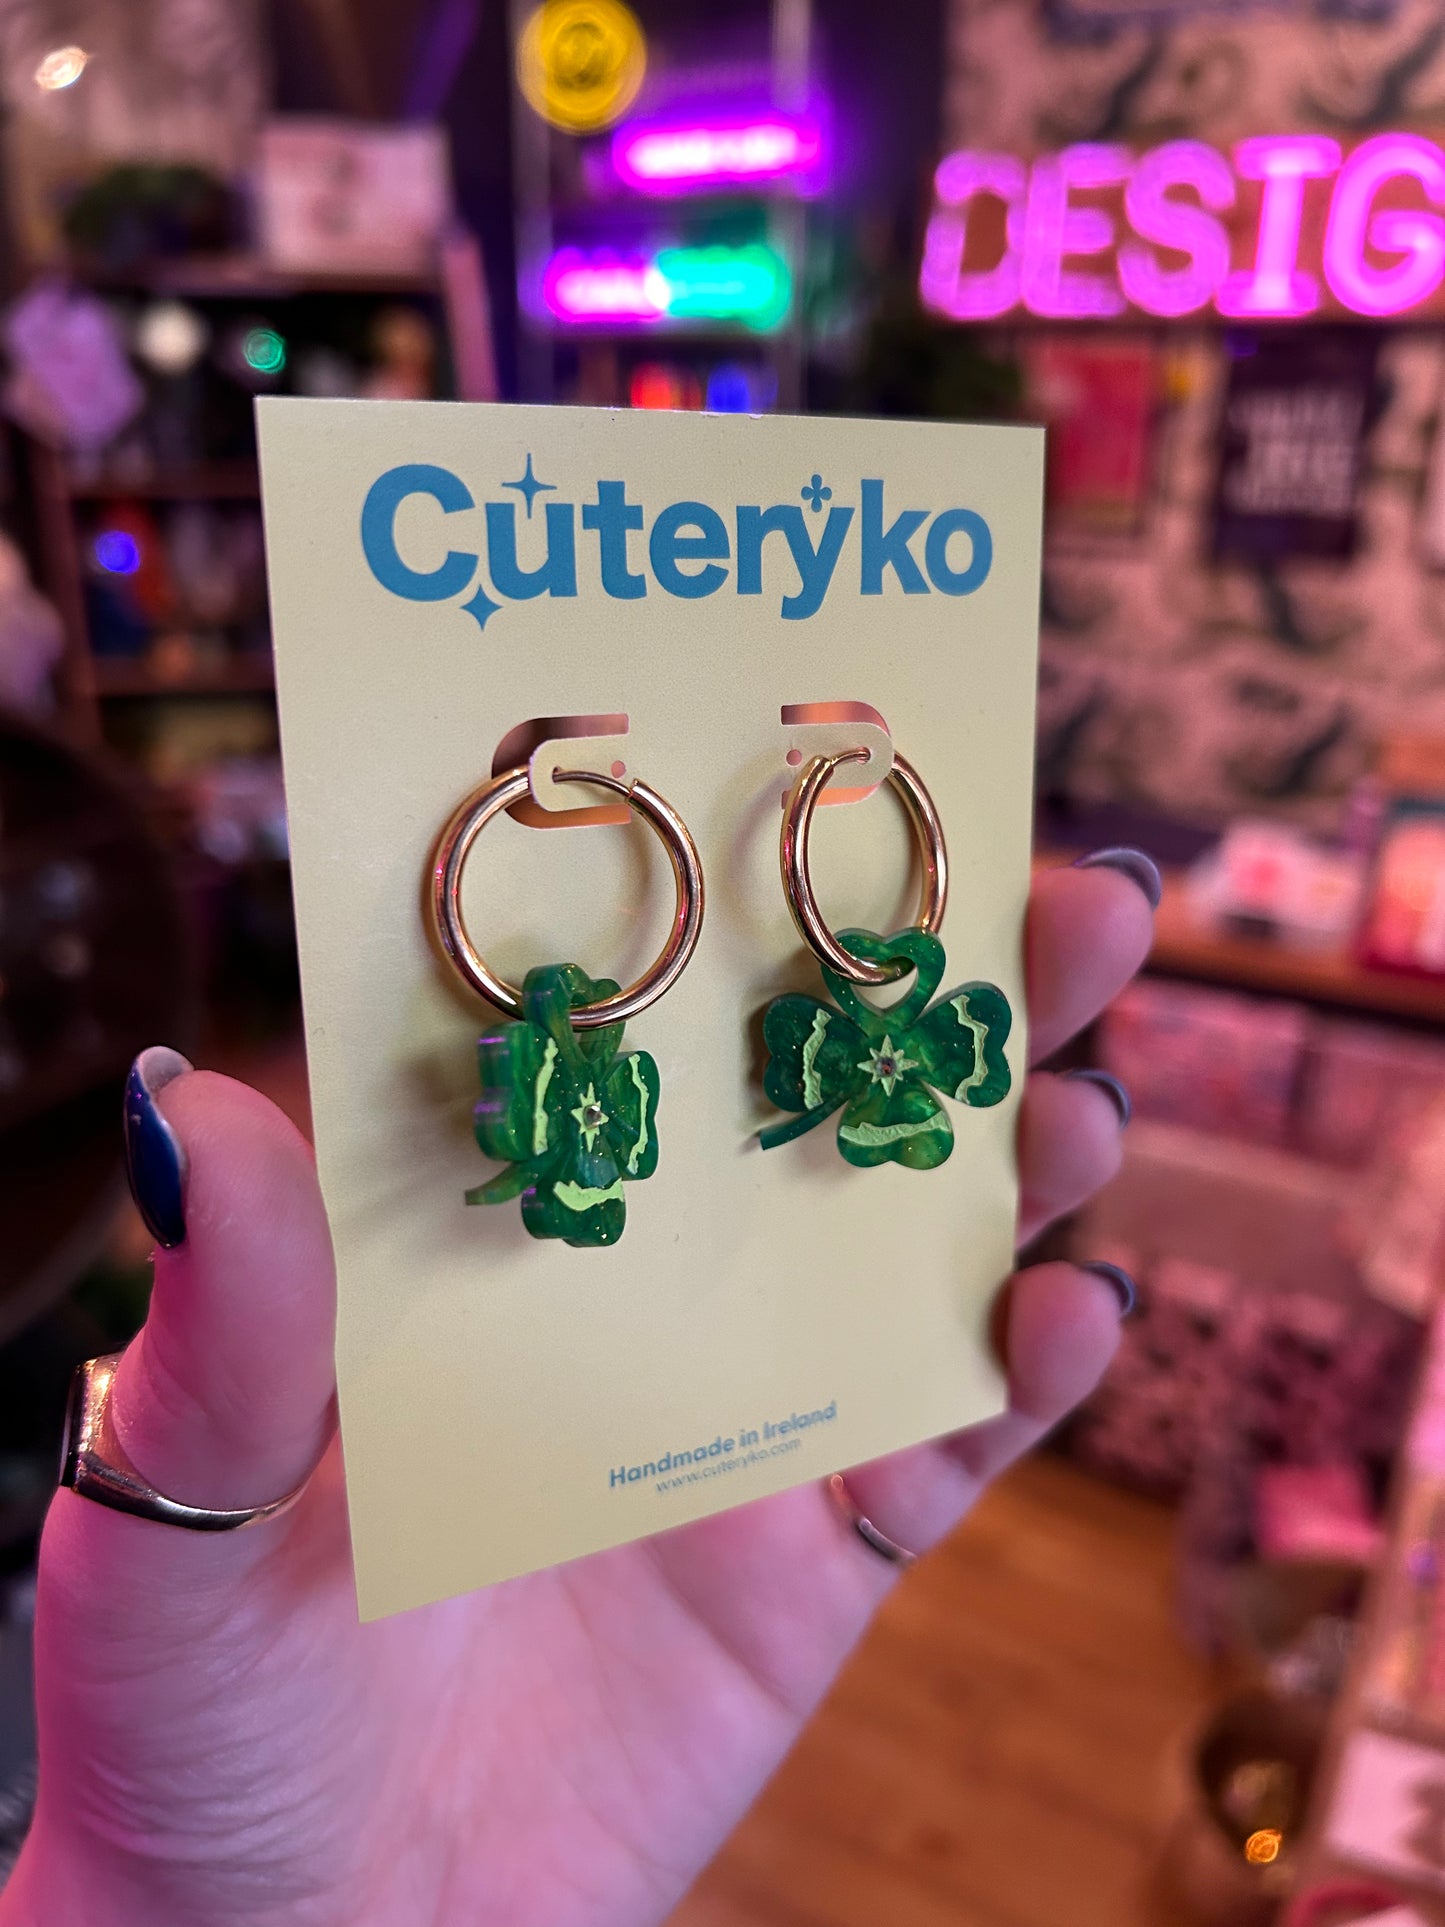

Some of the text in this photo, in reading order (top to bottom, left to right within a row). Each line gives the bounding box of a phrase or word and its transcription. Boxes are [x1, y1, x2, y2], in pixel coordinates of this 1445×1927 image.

[361, 463, 993, 621] Cuteryko
[609, 1400, 837, 1488] Handmade in Ireland
[656, 1438, 801, 1493] www.cuteryko.com
